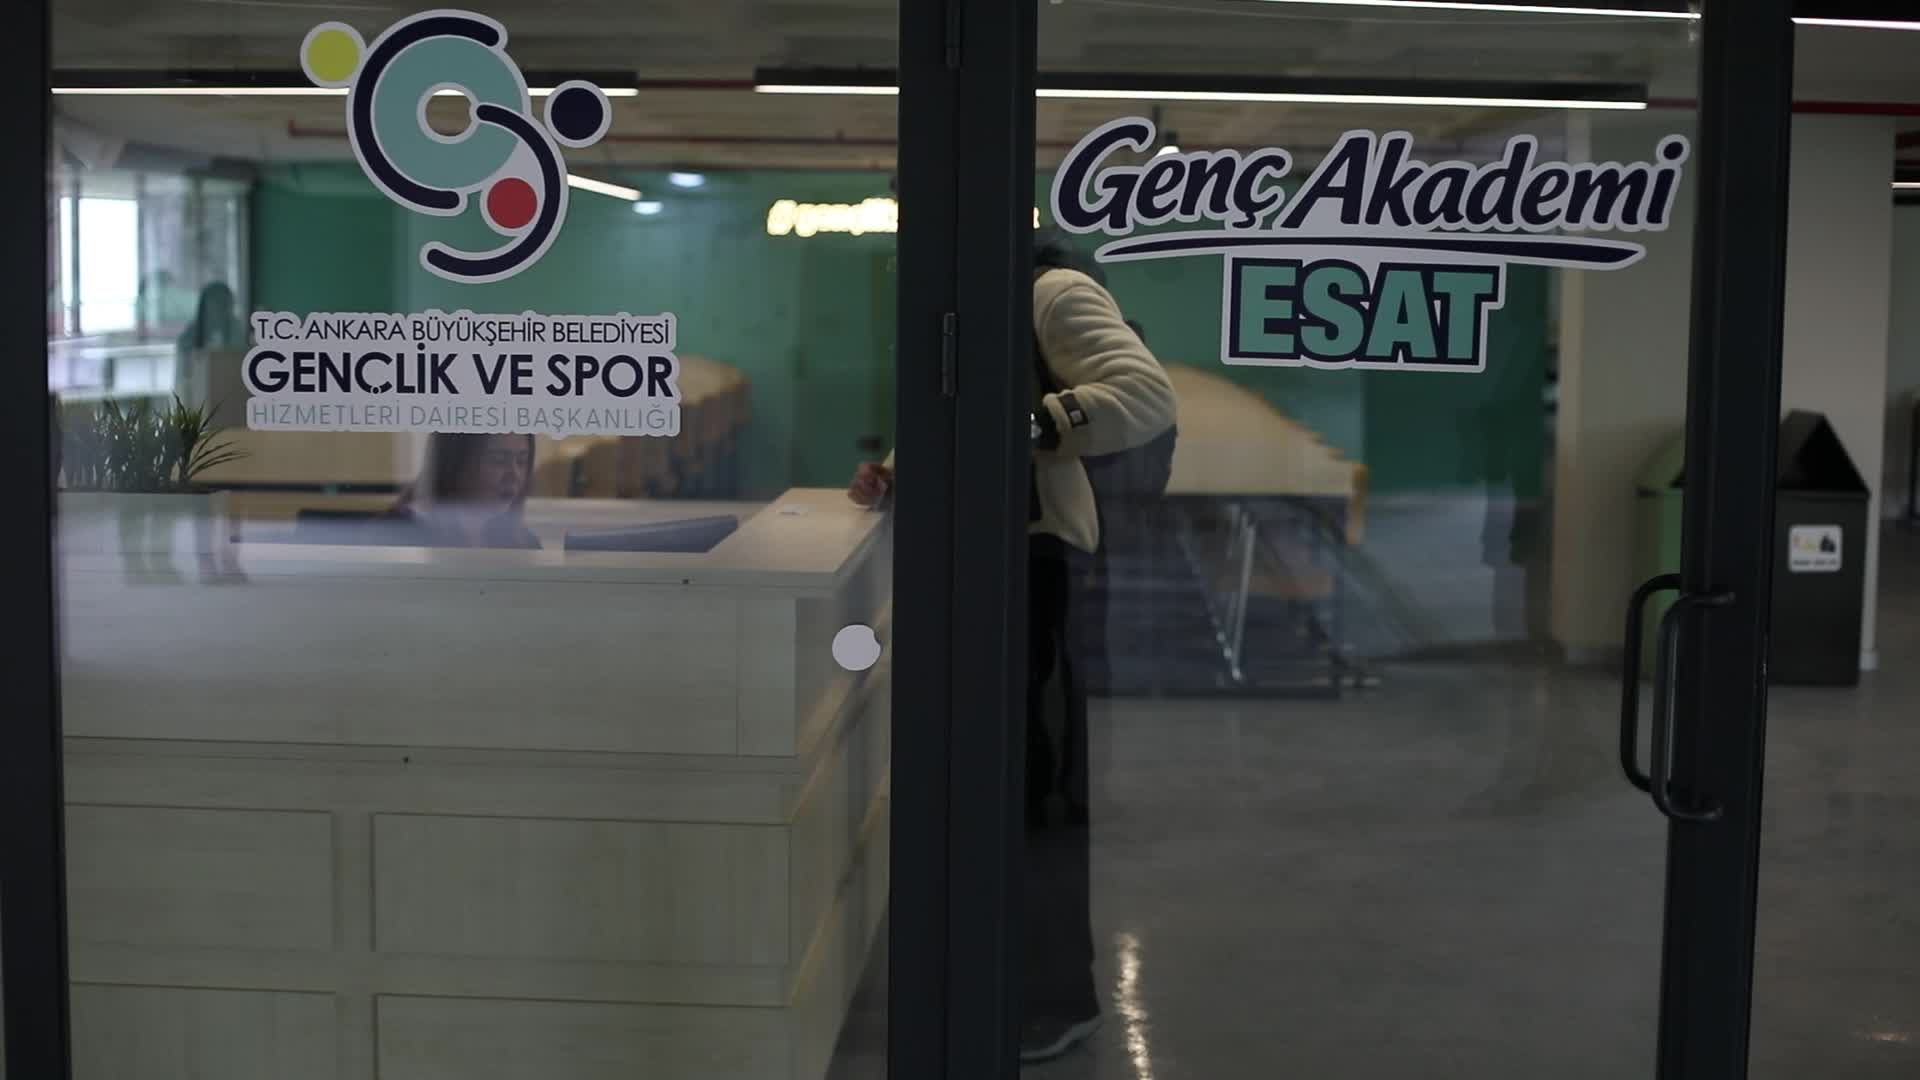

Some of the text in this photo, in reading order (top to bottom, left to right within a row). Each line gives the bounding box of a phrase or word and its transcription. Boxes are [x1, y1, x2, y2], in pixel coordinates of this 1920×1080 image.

[1059, 123, 1685, 230] Genç Akademi
[257, 316, 669, 347] T.C. ANKARA BÜYÜKŞEHİR BELEDİYESİ
[1230, 257, 1501, 365] ESAT
[248, 342, 673, 398] GENÇLİK VE SPOR
[253, 400, 673, 432] HİZMETLERİ DAİRESİ BAŞKANLIĞI
